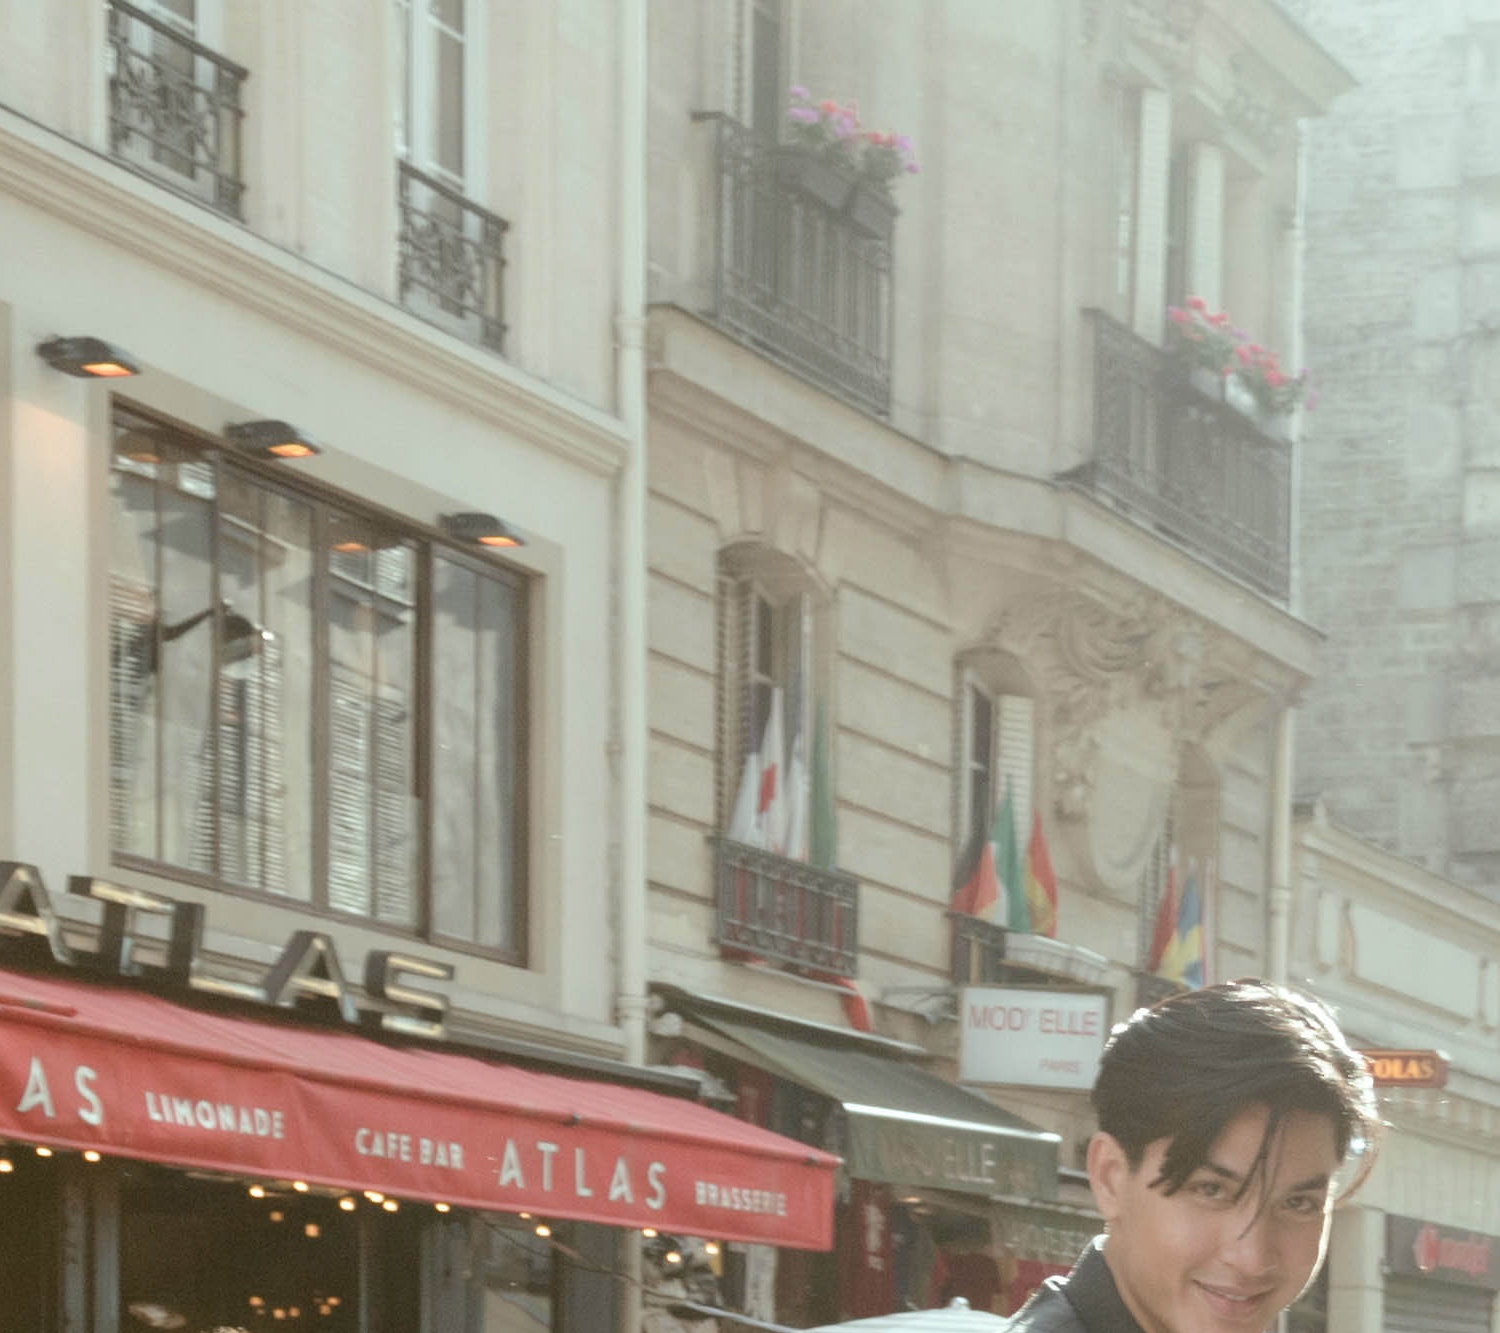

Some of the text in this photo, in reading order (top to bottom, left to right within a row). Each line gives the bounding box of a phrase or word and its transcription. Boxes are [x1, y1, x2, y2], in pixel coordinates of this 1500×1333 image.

[1040, 1008, 1098, 1037] ELLE
[145, 1091, 284, 1139] LIMONADE
[355, 1127, 411, 1163] CAFE
[419, 1138, 465, 1171] BAR
[499, 1138, 667, 1211] ATLAS
[695, 1180, 788, 1218] BRASSERIE
